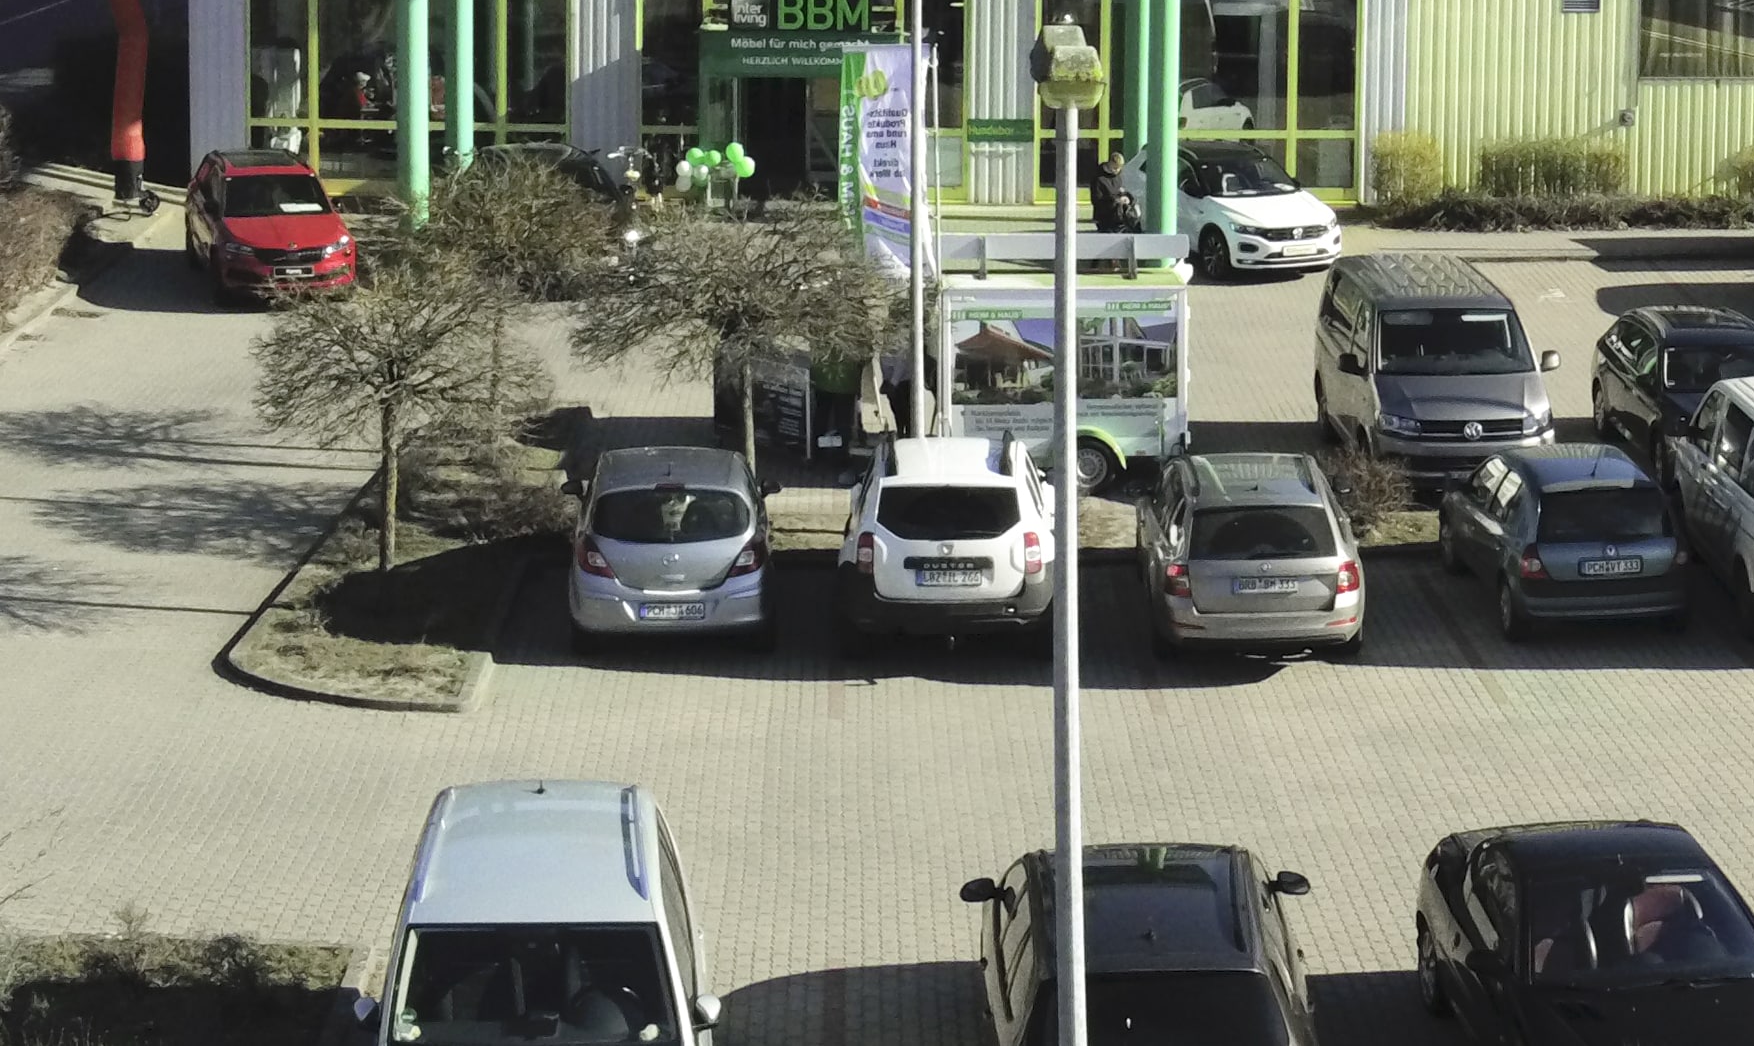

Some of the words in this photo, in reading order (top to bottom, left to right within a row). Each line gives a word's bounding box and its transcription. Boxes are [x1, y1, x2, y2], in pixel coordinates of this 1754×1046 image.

[731, 37, 766, 49] Möbel
[769, 38, 786, 49] für
[789, 39, 816, 49] mich
[742, 56, 788, 65] HERZLICH
